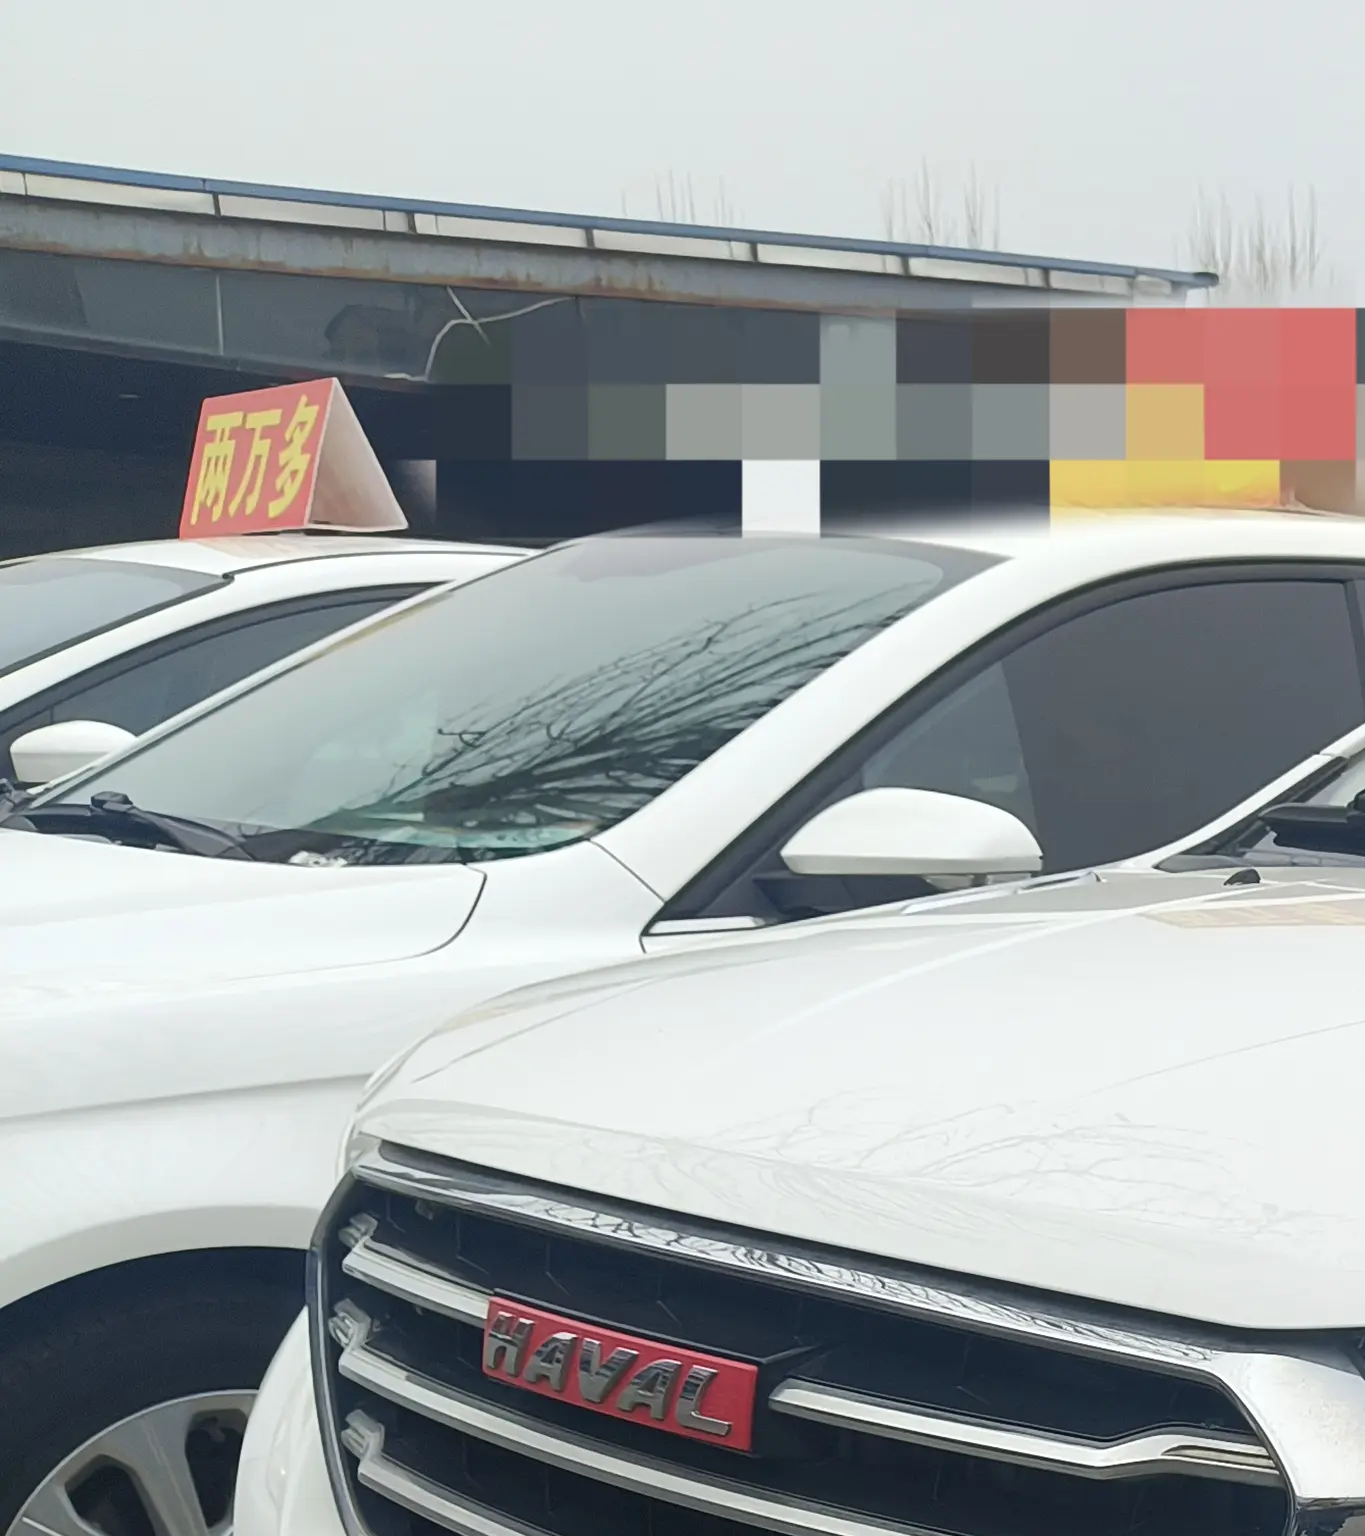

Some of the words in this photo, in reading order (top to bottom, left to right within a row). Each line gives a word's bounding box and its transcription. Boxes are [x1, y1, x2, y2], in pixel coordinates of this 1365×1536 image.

[190, 394, 320, 525] 两万多
[486, 1310, 733, 1437] HAVAL
